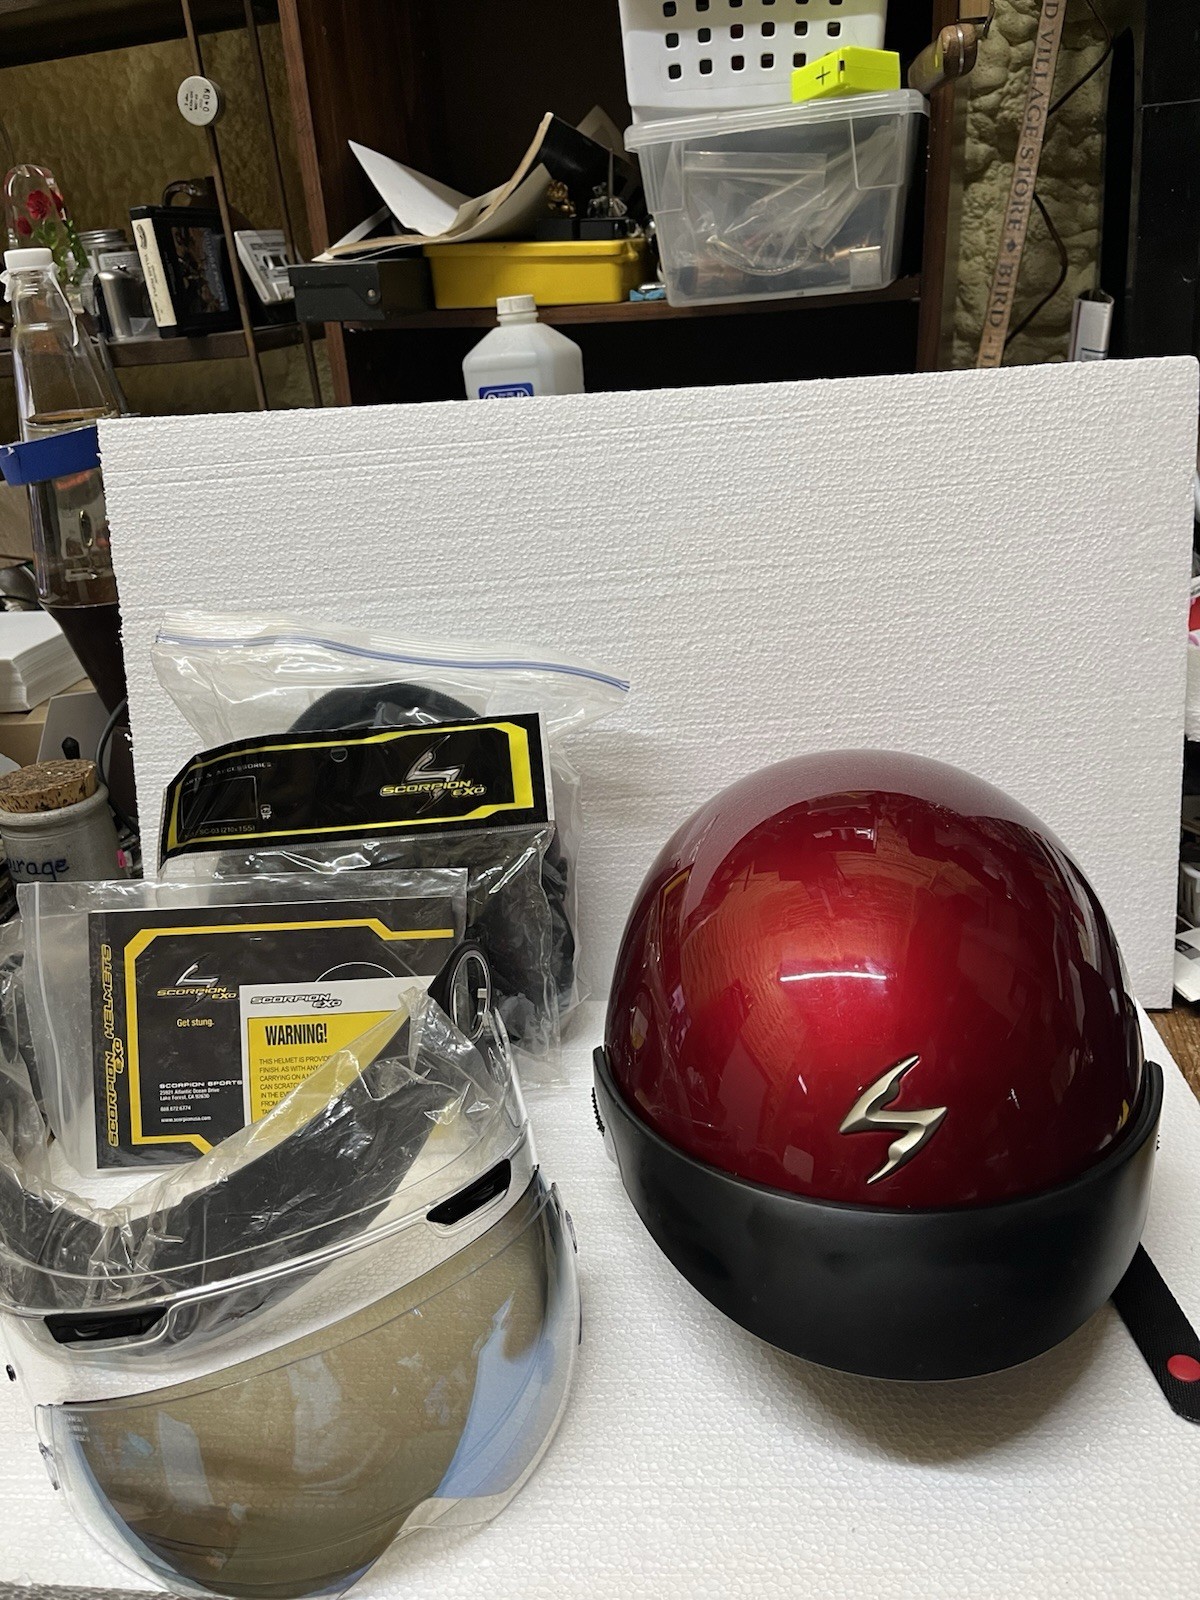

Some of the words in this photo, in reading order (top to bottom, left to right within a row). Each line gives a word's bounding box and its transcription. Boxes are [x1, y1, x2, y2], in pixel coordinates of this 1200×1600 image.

[1024, 28, 1056, 138] VILLAGE
[1006, 146, 1035, 231] STORE
[381, 780, 472, 795] SCORPION
[452, 786, 486, 797] EXO
[101, 944, 115, 1039] HELMETS
[156, 986, 228, 998] SCORPION
[211, 992, 238, 1000] EXO
[250, 993, 332, 1005] SCORPION
[312, 1000, 343, 1009] EXO
[176, 1018, 190, 1027] Get
[191, 1018, 215, 1027] stung.
[265, 1023, 328, 1046] WARNING!
[113, 1038, 124, 1074] EXO
[274, 1056, 298, 1064] HELMET
[259, 1074, 291, 1082] CARRYING
[105, 1051, 119, 1147] SCORPION
